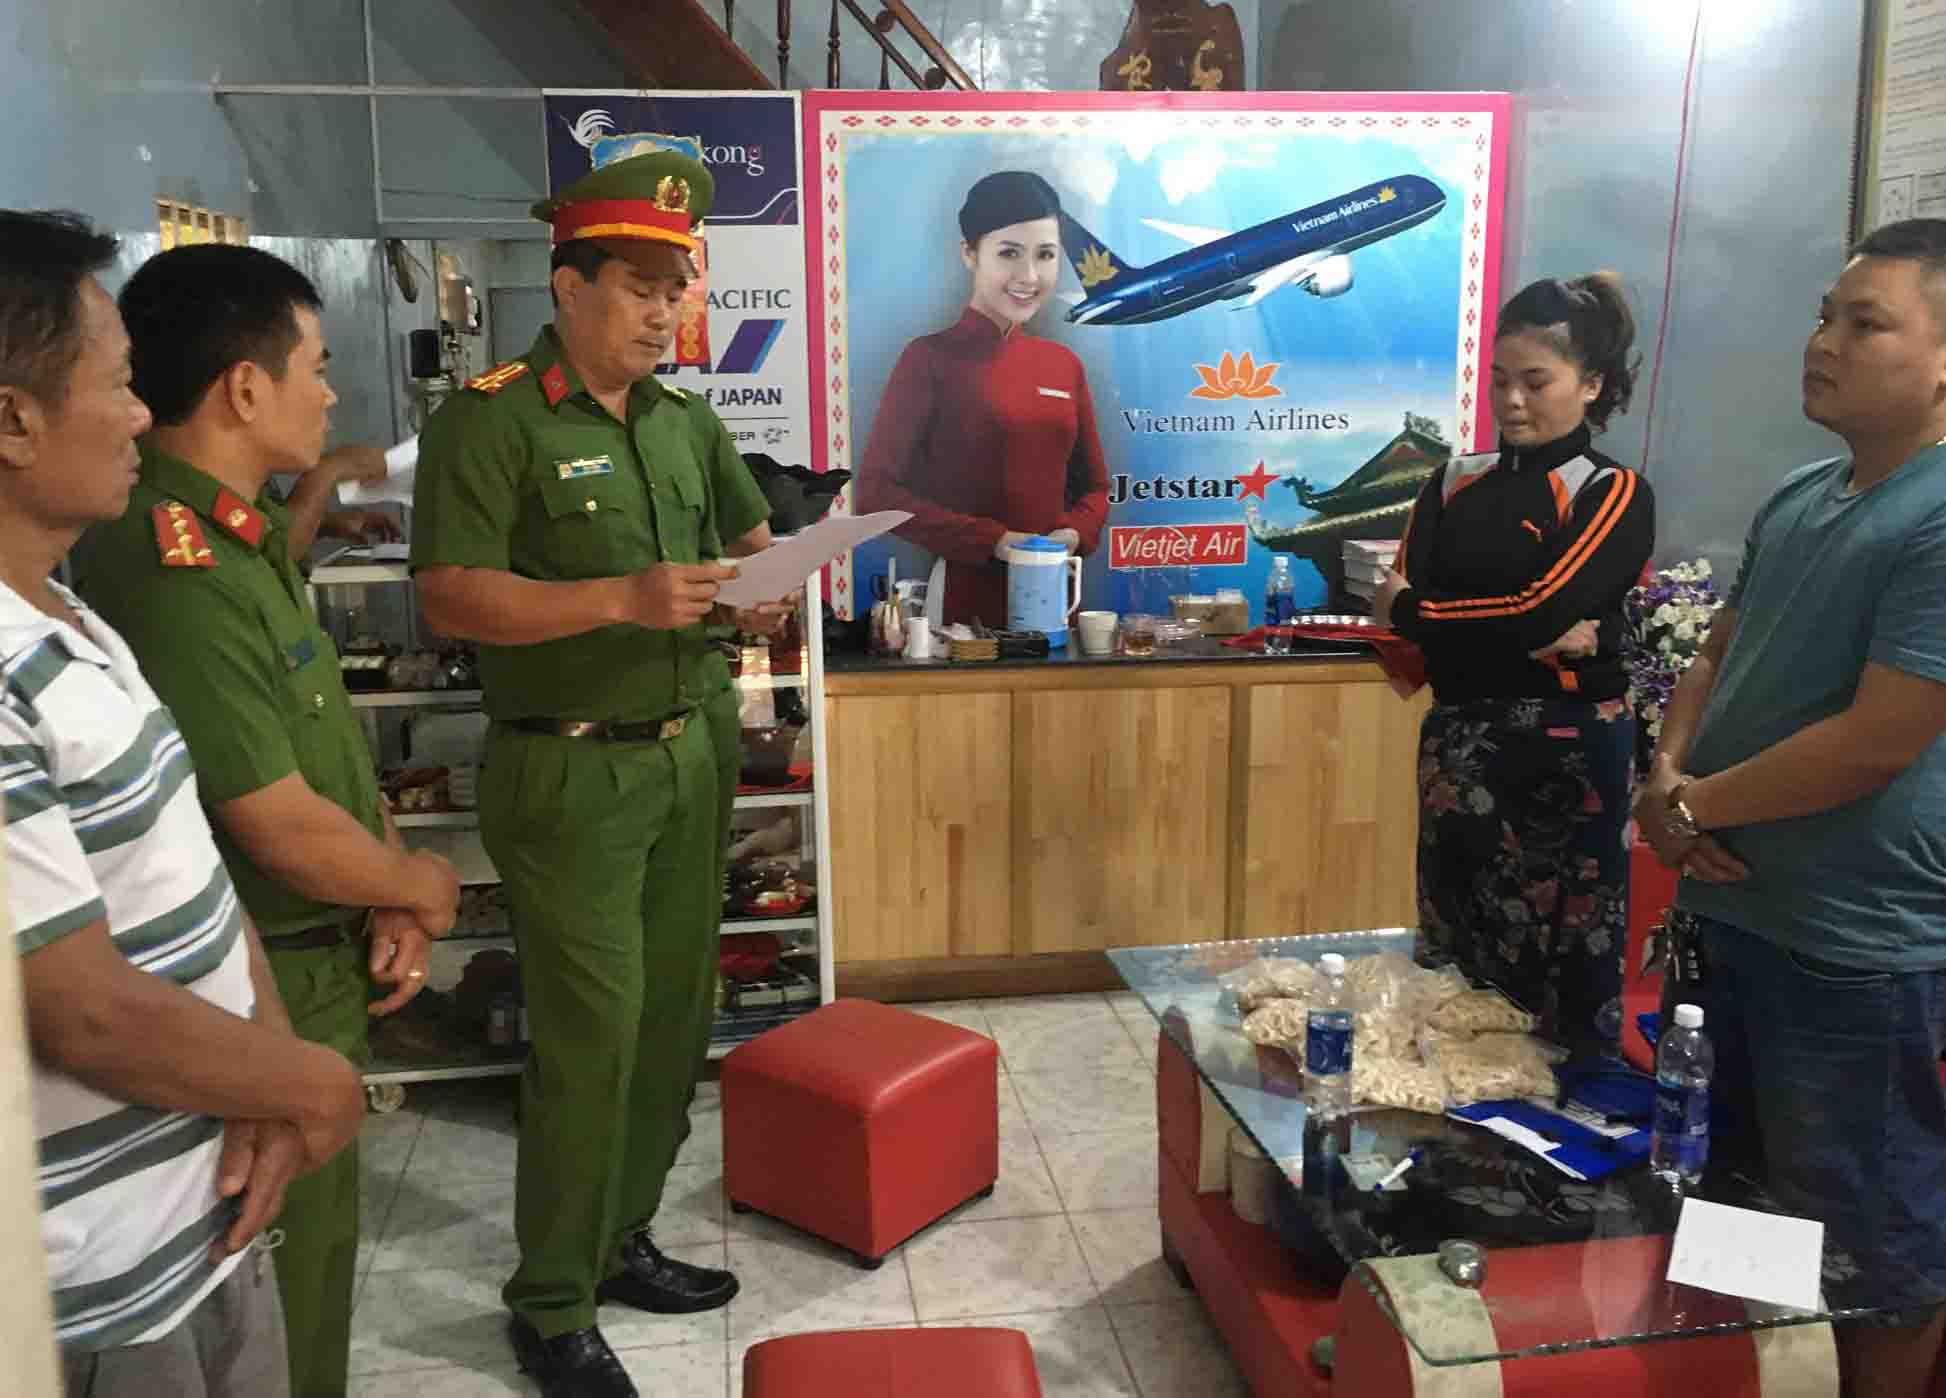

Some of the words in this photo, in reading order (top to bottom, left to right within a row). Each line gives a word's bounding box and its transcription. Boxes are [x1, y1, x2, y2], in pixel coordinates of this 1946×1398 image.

[696, 135, 765, 177] kong
[1291, 210, 1338, 233] Vietnam
[1338, 197, 1377, 217] Airlines
[705, 289, 792, 309] ACIFIC
[716, 387, 783, 407] JAPAN
[1121, 408, 1236, 434] Vietnam
[1245, 408, 1350, 432] Airlines
[1108, 473, 1241, 504] Jetstar
[1117, 530, 1199, 563] Vietjet
[1203, 530, 1242, 556] Air
